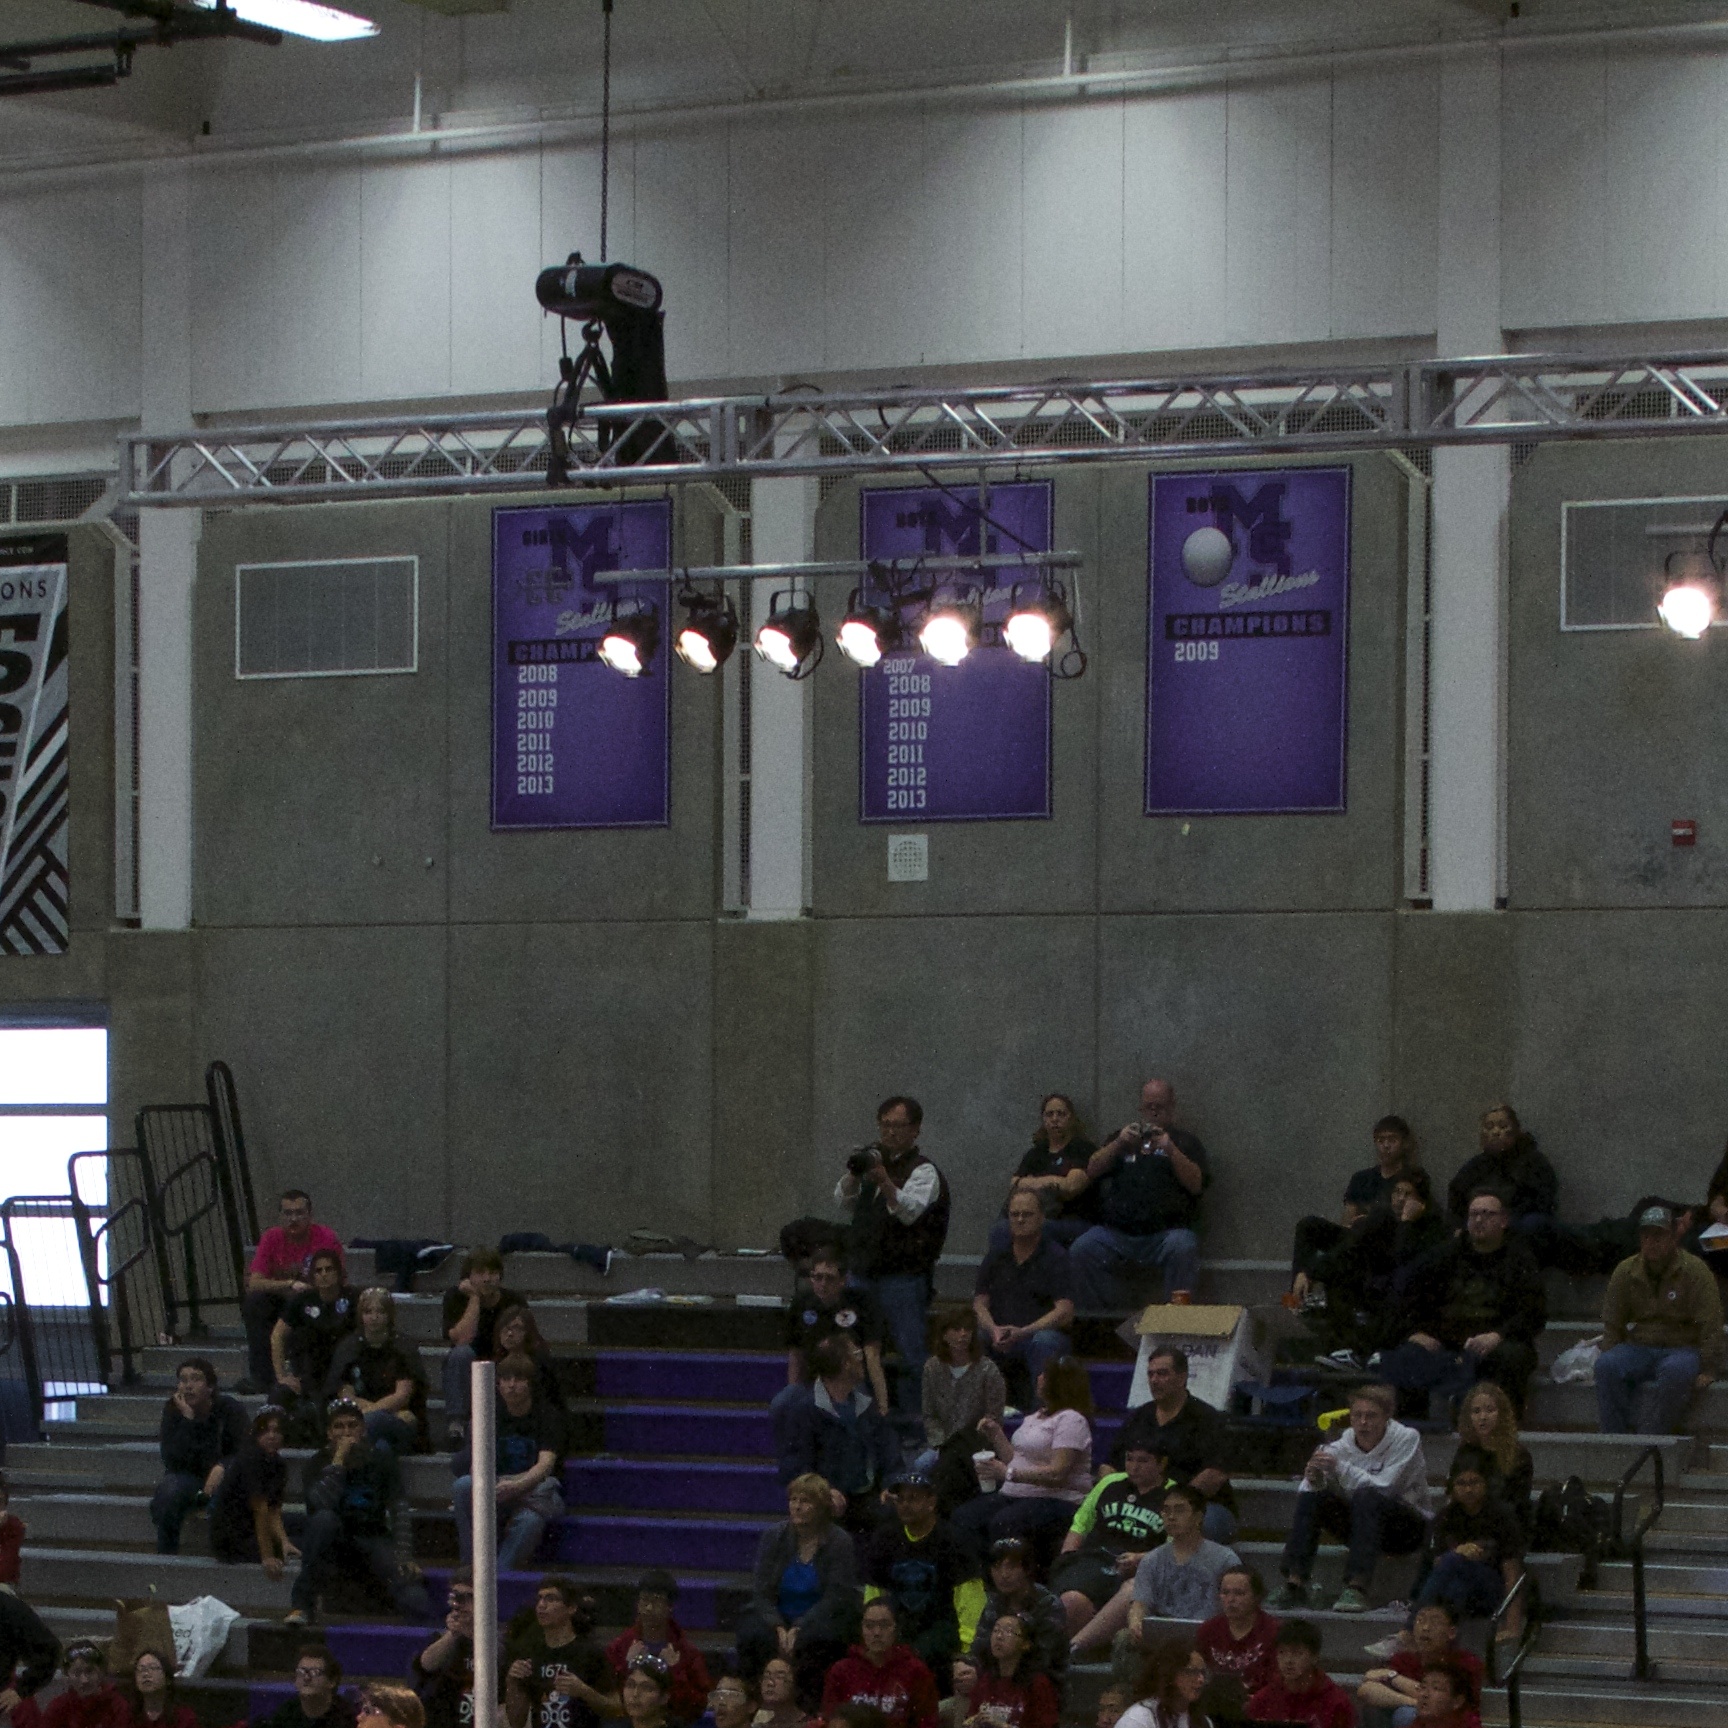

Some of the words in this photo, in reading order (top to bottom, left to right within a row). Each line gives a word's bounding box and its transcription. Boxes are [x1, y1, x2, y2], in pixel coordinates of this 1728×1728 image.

[1174, 614, 1325, 637] CHAMPIONS
[514, 643, 595, 662] CHAMP
[1174, 640, 1220, 662] 2009
[518, 664, 558, 683] 2008
[883, 657, 915, 675] 2007
[889, 675, 931, 695] 2008
[518, 689, 558, 708] 2009
[889, 698, 931, 718] 2009
[518, 711, 554, 730] 2010
[888, 721, 927, 741] 2010
[517, 733, 551, 752] 2011
[517, 754, 554, 773] 2012
[887, 744, 924, 764] 2011
[517, 776, 554, 795] 2013
[887, 767, 926, 787] 2012
[887, 790, 926, 810] 2013
